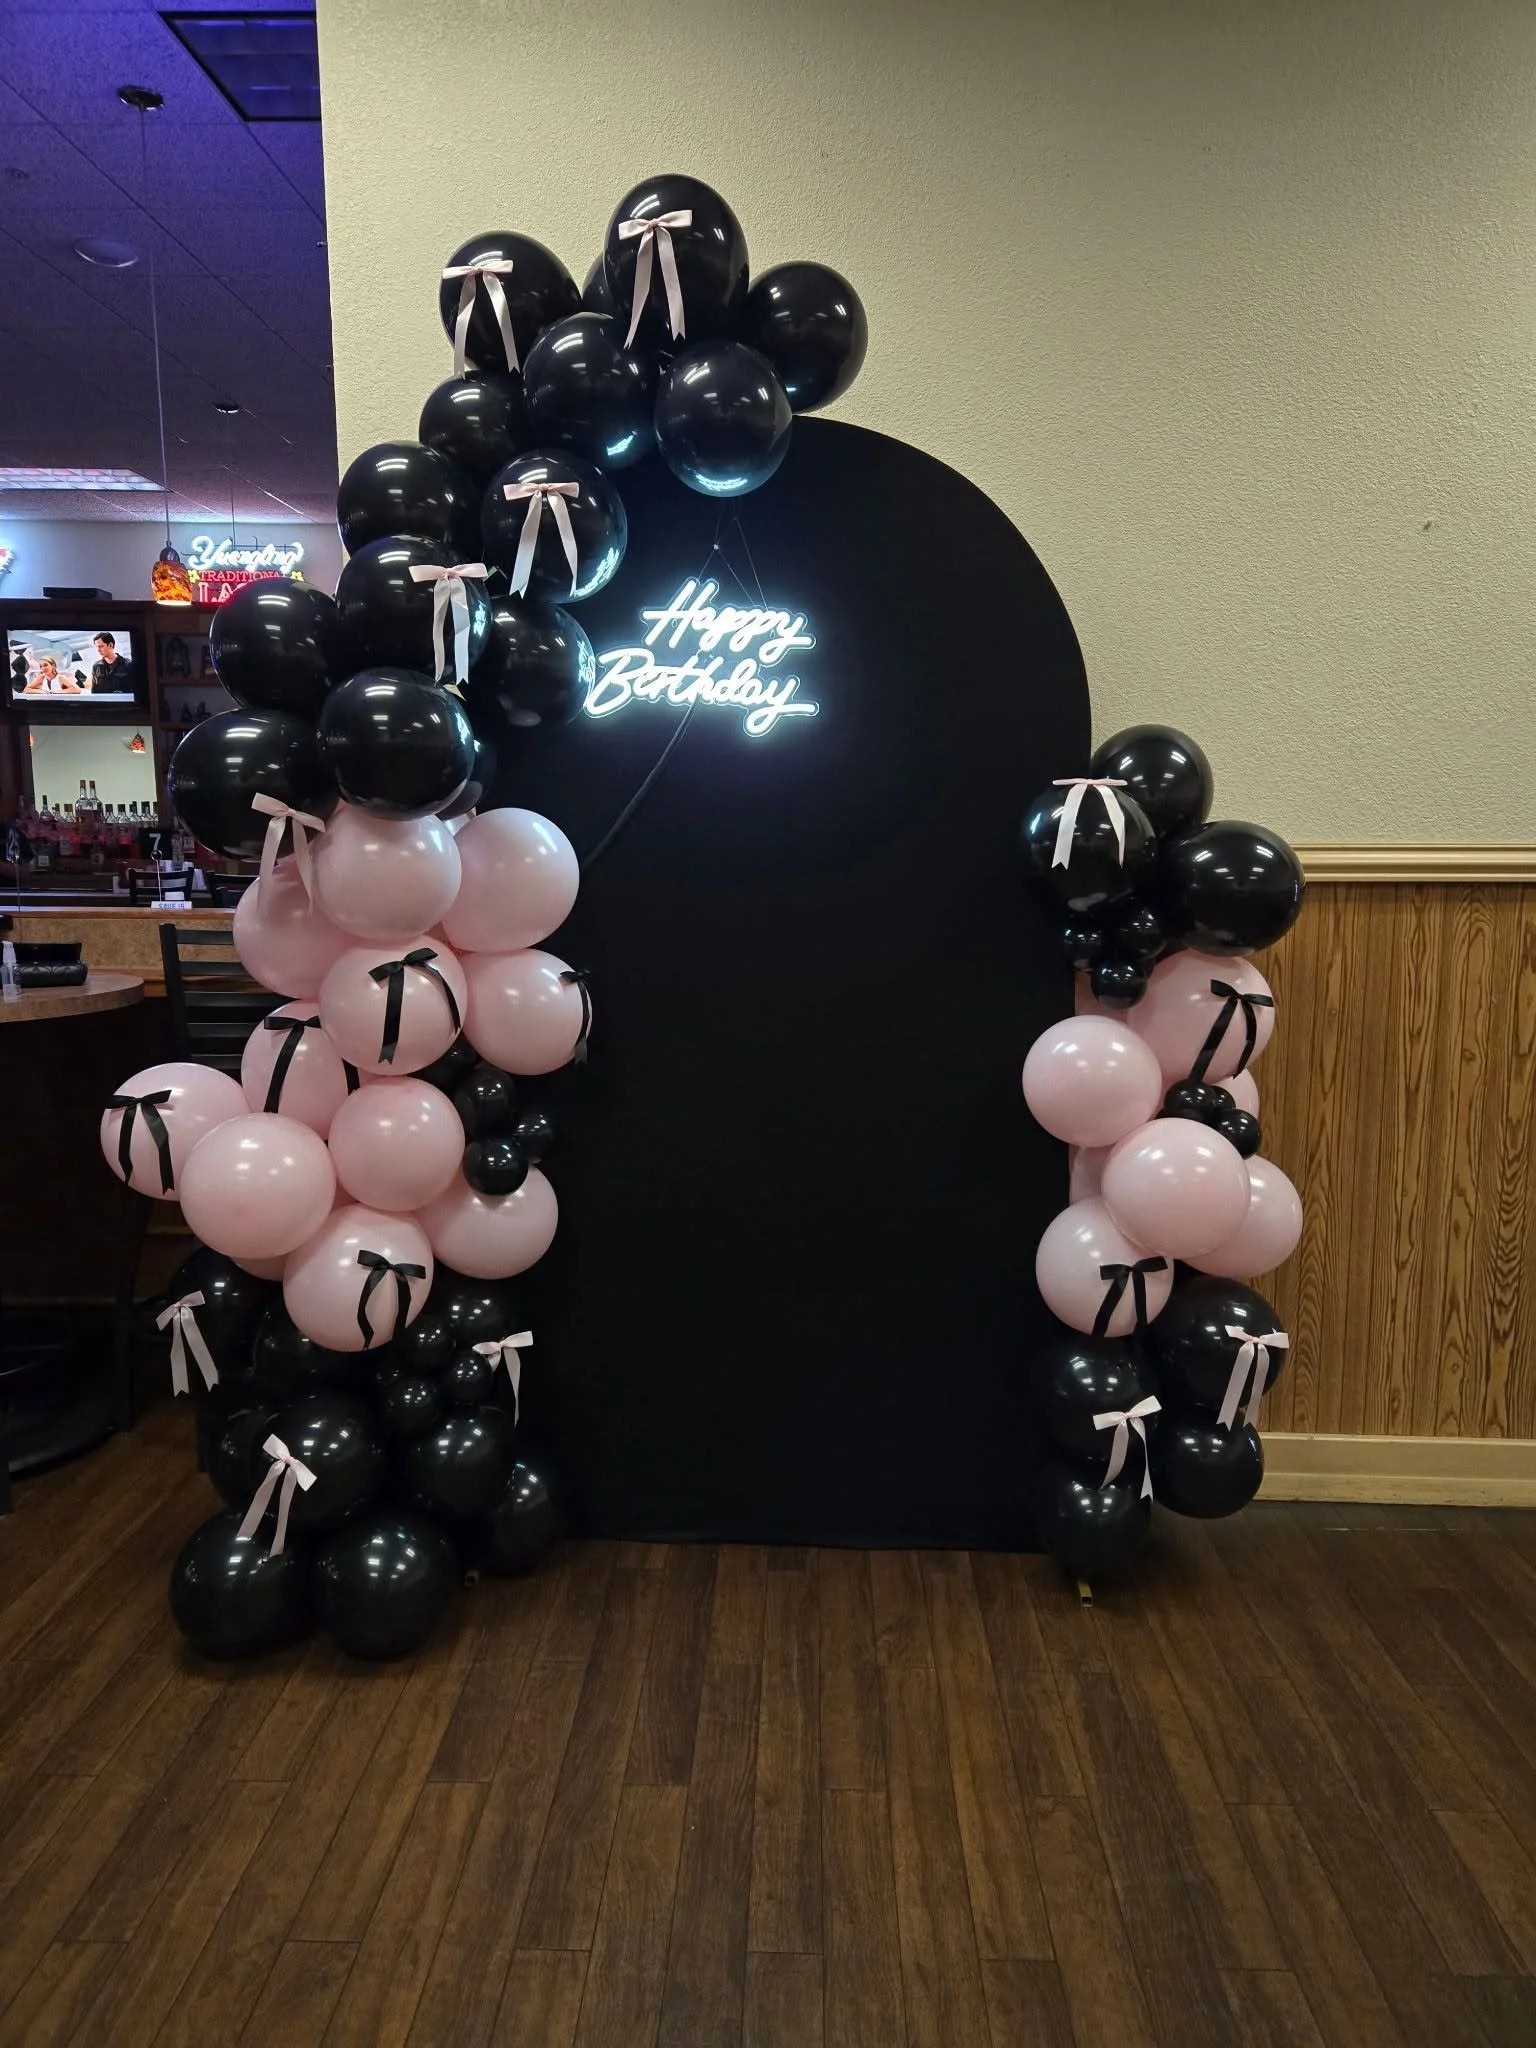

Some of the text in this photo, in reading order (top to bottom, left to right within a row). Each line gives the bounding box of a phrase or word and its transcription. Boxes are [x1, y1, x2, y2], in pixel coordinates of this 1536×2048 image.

[188, 535, 304, 573] Yuengling
[641, 577, 815, 665] Happy
[583, 646, 817, 735] Birthday
